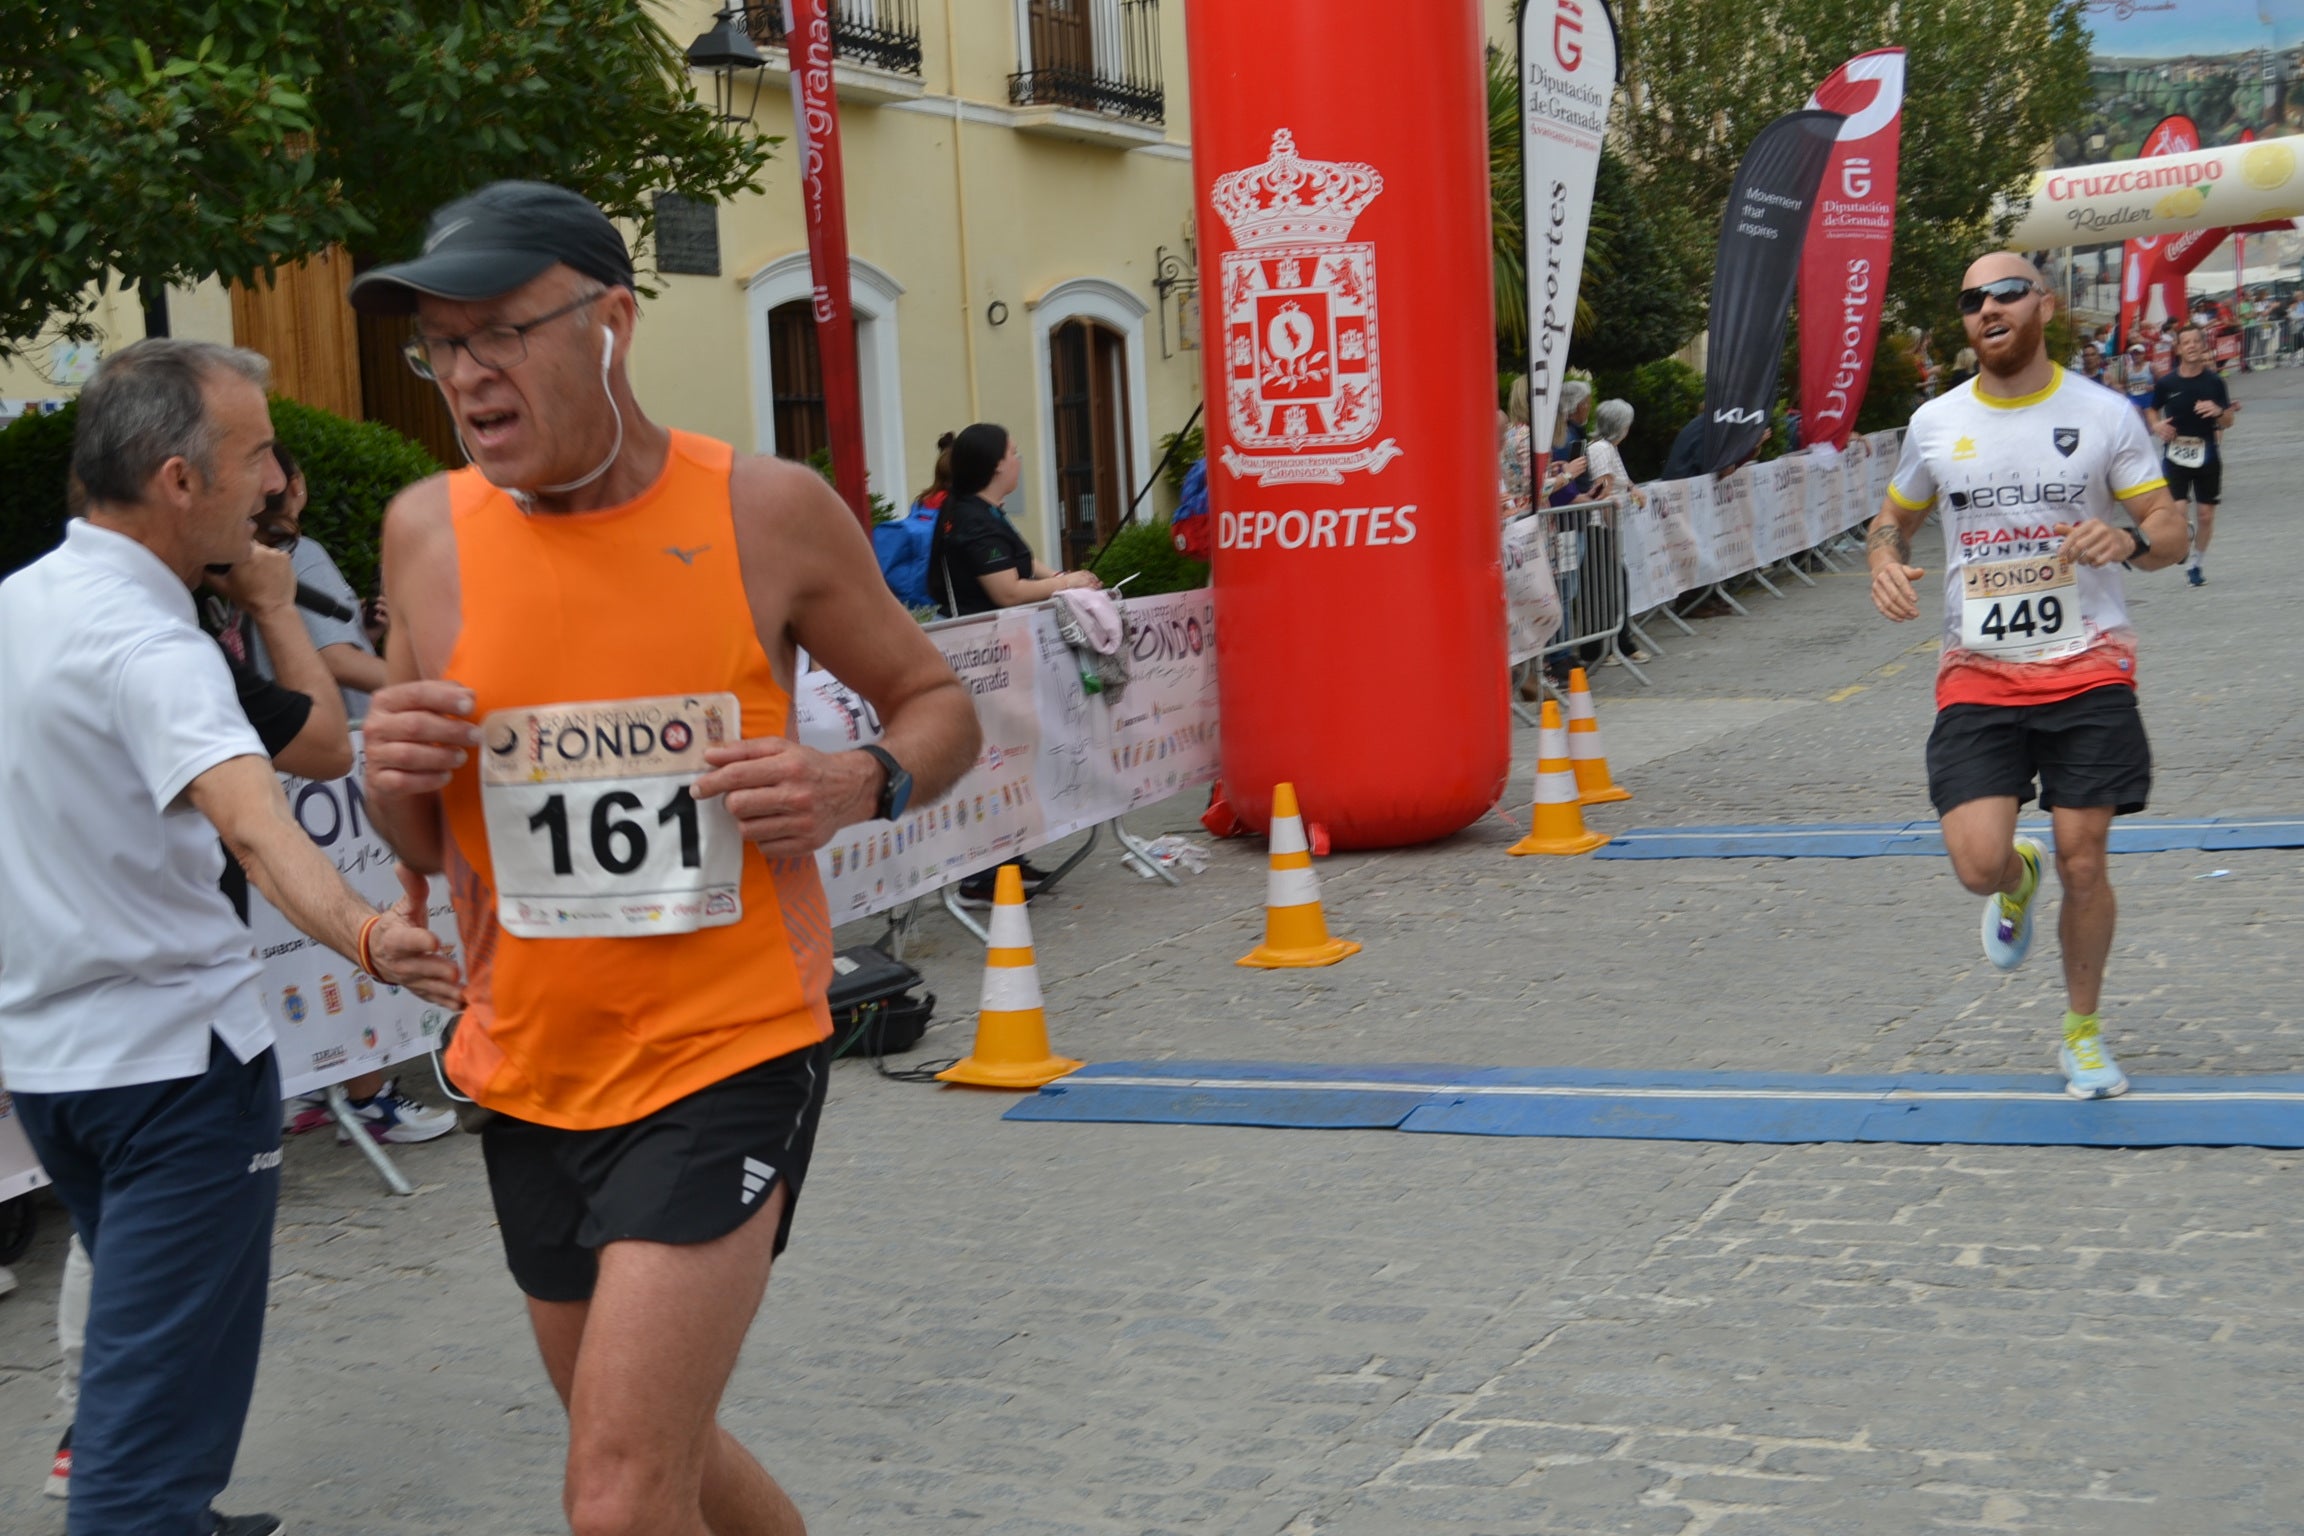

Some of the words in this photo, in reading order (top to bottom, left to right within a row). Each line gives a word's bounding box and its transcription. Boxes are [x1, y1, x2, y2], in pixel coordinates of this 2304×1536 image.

[1529, 63, 1602, 107] Diputación
[1530, 91, 1547, 114] de
[1549, 97, 1601, 132] Granada
[1744, 187, 1802, 211] Movement
[2048, 158, 2223, 201] Cruzcampo
[1741, 204, 1766, 219] that
[1822, 201, 1890, 214] Diputación
[1822, 215, 1839, 227] de
[1840, 214, 1889, 227] Granada
[2068, 207, 2152, 231] Radler
[1737, 220, 1778, 240] inspires
[1533, 179, 1567, 404] Deportes
[1815, 258, 1870, 422] Deportes
[1219, 505, 1417, 549] DEPORTES
[1983, 566, 2054, 588] FONDO
[1981, 596, 2064, 641] 449
[945, 639, 1012, 672] iputación
[538, 719, 693, 761] FONDO
[529, 785, 701, 876] 161
